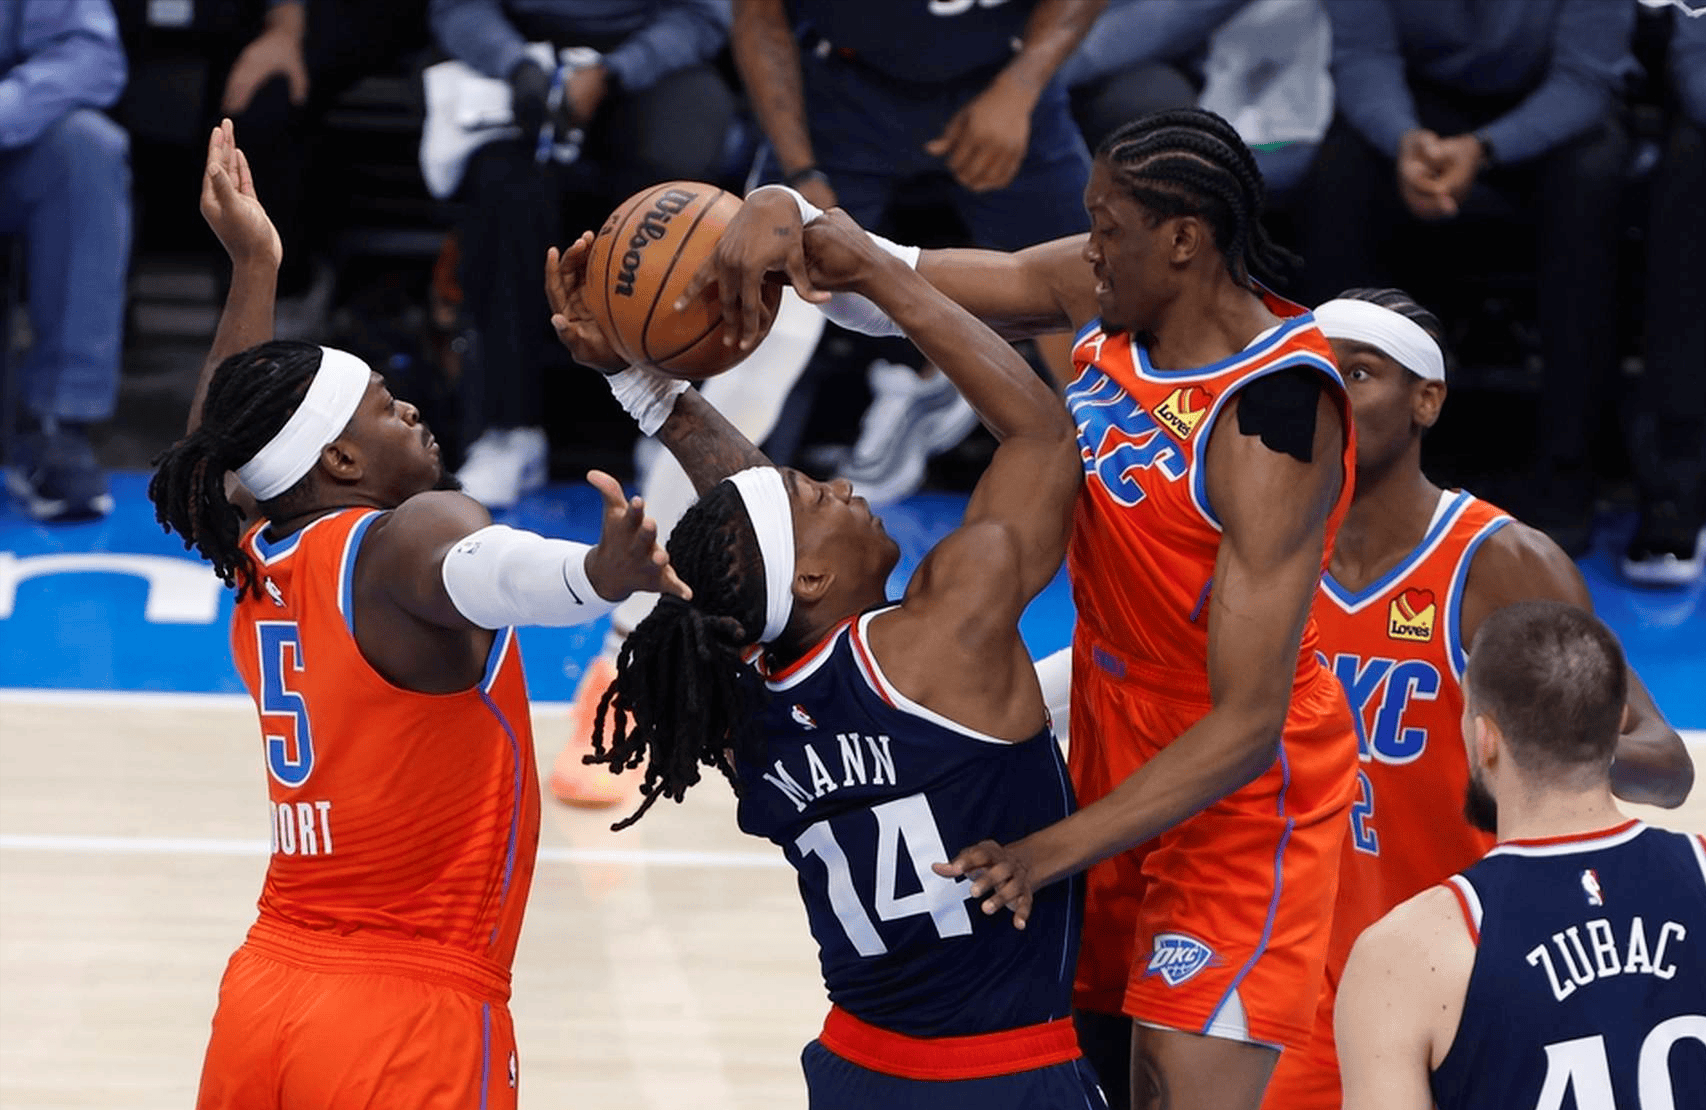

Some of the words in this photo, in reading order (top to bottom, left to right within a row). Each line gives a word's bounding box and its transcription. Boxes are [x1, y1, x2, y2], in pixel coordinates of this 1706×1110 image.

[614, 187, 699, 297] Wilson
[255, 620, 315, 788] 5
[1314, 650, 1442, 765] KC
[762, 732, 897, 812] MANN
[794, 792, 977, 957] 14
[1148, 946, 1200, 970] OKC
[1525, 916, 1686, 1002] ZUBAC
